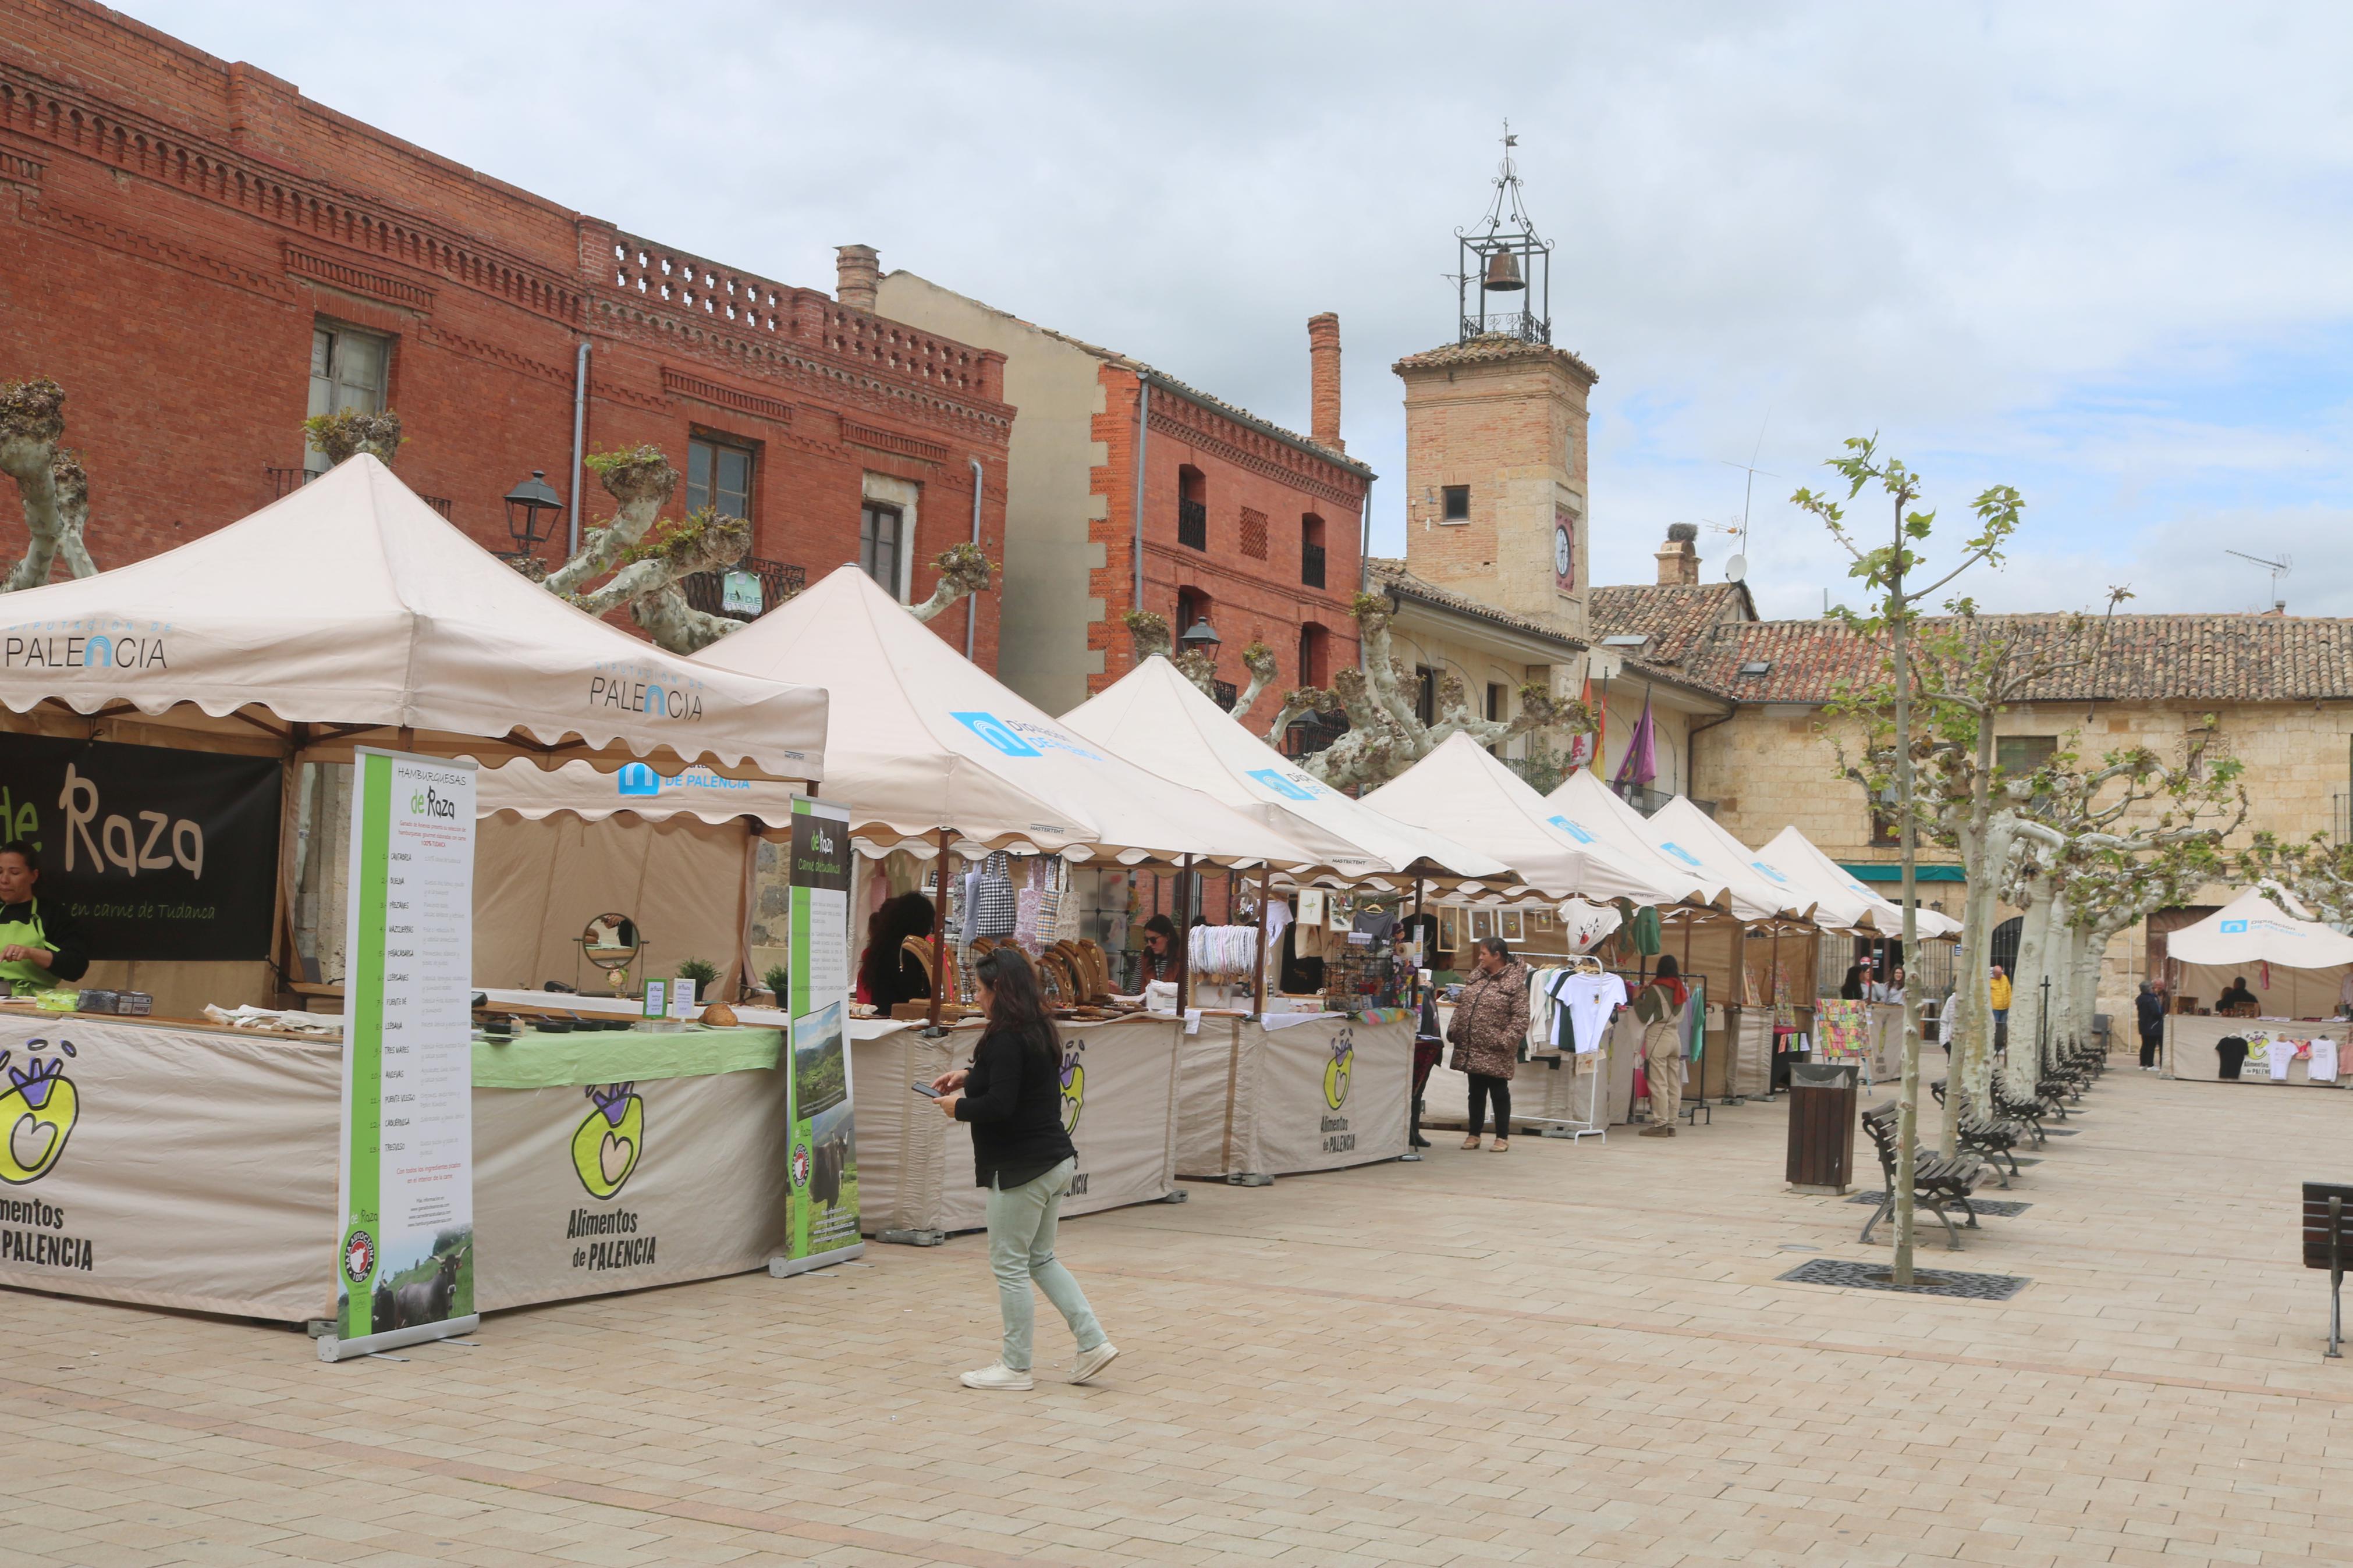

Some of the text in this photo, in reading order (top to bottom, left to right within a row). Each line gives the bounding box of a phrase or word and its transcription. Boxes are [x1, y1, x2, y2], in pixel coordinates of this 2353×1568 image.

[150, 622, 172, 632] DE
[398, 767, 466, 786] HAMBURGUESAS
[665, 774, 750, 790] DE PALENCIA
[411, 785, 455, 820] de Raza
[59, 763, 204, 880] Raza
[1030, 825, 1064, 834] MASTERTENT
[811, 827, 833, 855] de Raza
[70, 899, 215, 919] en carne de Tudanca
[1321, 1115, 1348, 1133] Alimentos
[1329, 1133, 1355, 1153] PALENCIA
[361, 1208, 378, 1222] Raza
[567, 1208, 638, 1239] Alimentos
[2, 1229, 93, 1271] PALENCIA
[573, 1236, 656, 1271] de PALENCIA
[353, 1272, 368, 1282] 100%
